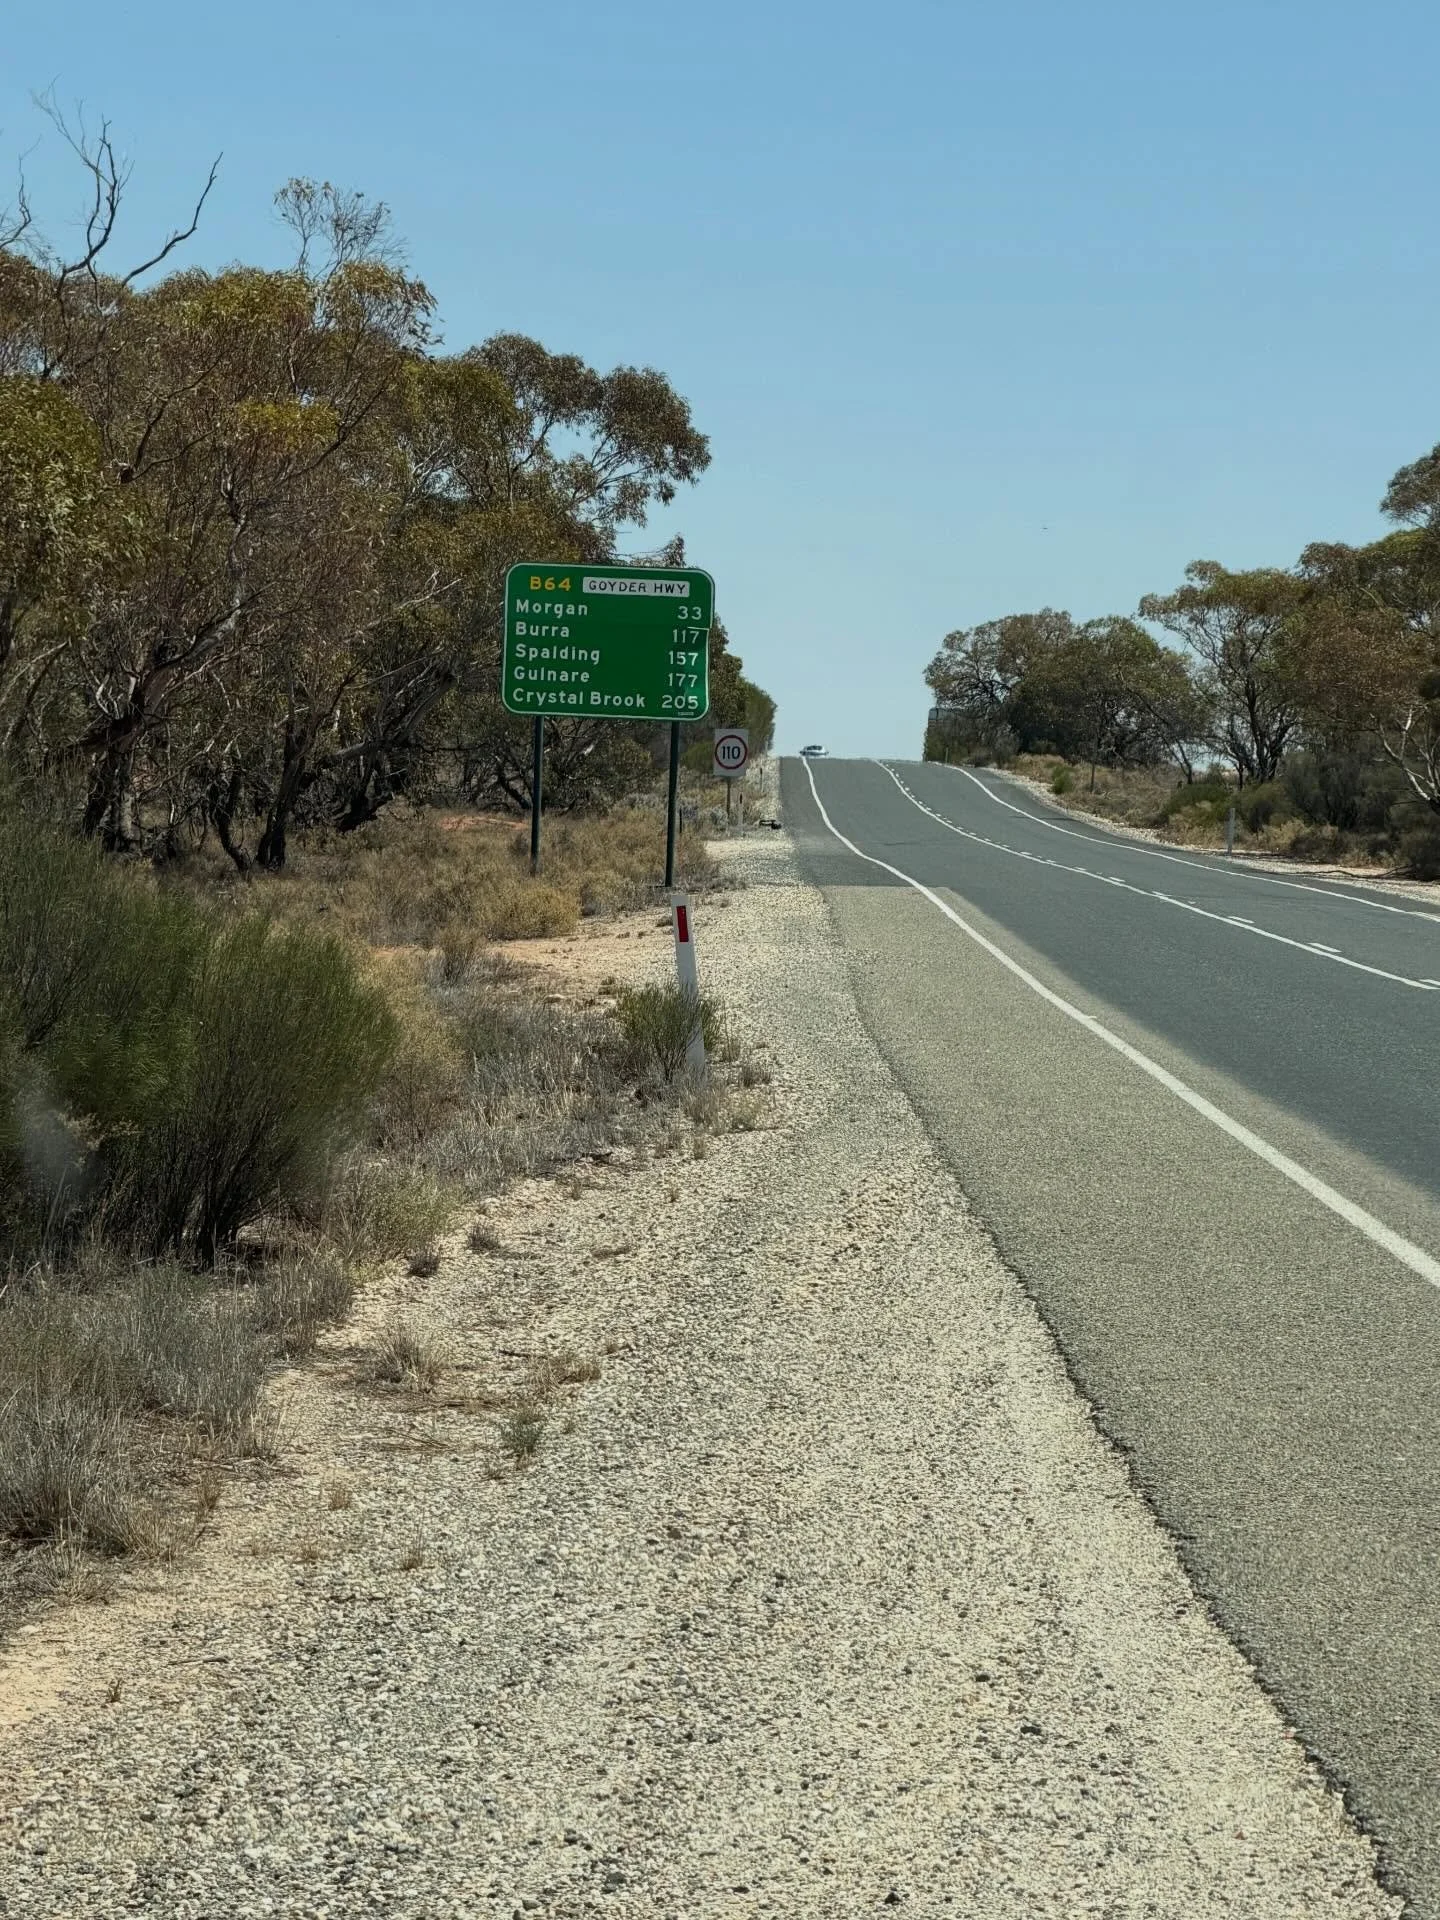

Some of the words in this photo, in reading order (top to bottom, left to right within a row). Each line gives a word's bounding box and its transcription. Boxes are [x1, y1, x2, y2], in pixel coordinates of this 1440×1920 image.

[530, 576, 571, 591] B64
[588, 580, 646, 593] GOYDER
[654, 583, 686, 594] HWY
[516, 600, 588, 617] Morgan
[677, 606, 702, 620] 33
[515, 622, 570, 637] Burra
[673, 629, 699, 644] 117
[515, 644, 600, 665] Spalding
[668, 651, 699, 666] 157
[514, 667, 590, 682] Gulnare
[667, 673, 698, 688] 177
[513, 689, 583, 706] Crystal
[590, 692, 646, 707] Brook
[662, 695, 698, 710] 205
[722, 746, 741, 759] 110
